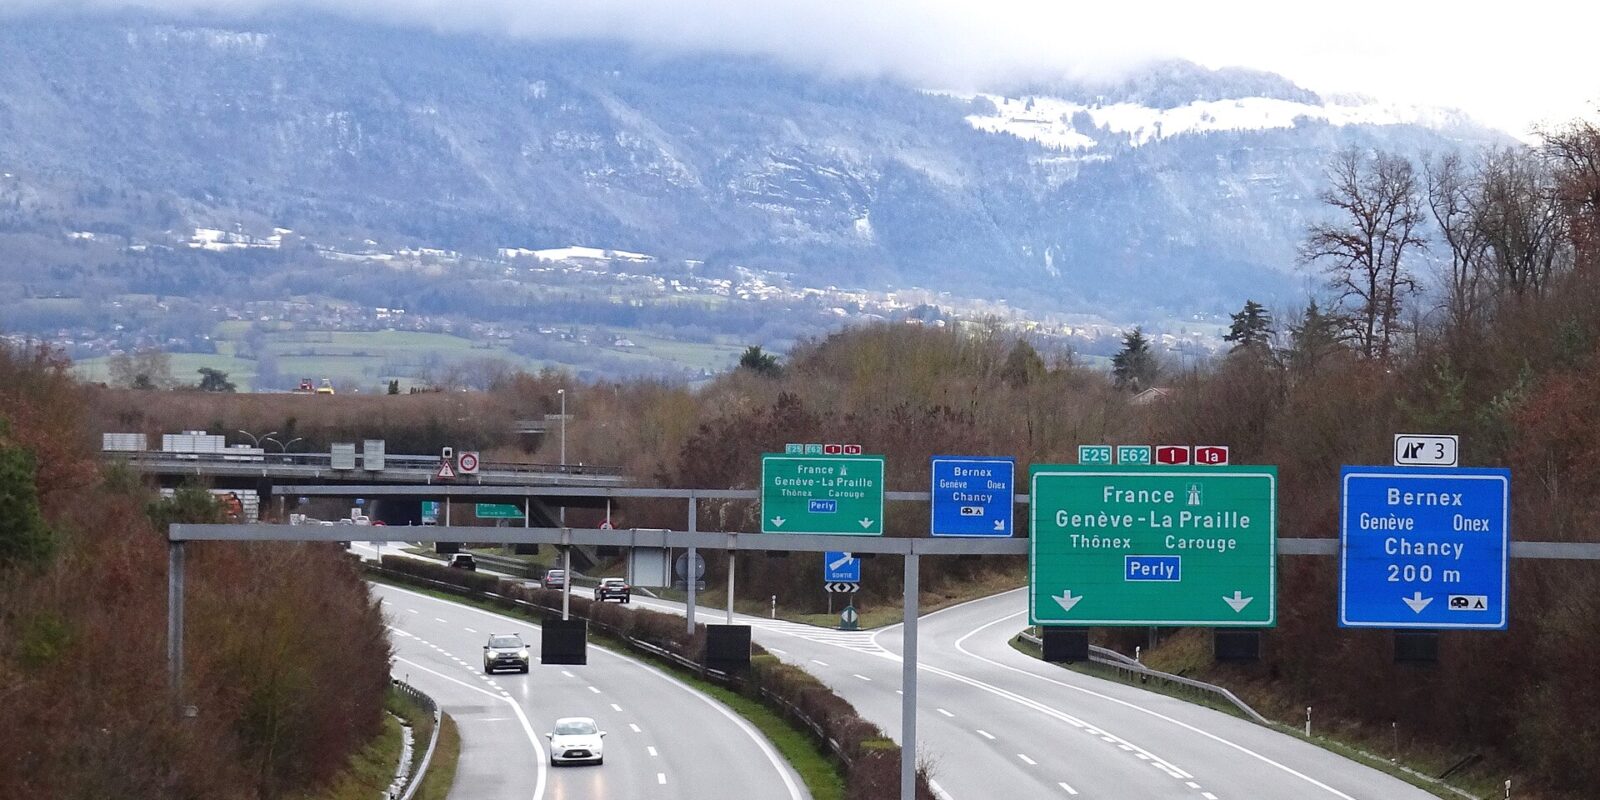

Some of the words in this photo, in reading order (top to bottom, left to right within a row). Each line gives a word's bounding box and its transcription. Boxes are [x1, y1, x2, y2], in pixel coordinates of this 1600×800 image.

[1081, 449, 1109, 462] E25
[1120, 449, 1148, 462] E62
[1169, 449, 1175, 462] 1
[1205, 449, 1219, 462] 1a
[1434, 443, 1445, 459] 3
[797, 464, 834, 474] France
[954, 466, 992, 477] Bernex
[836, 477, 873, 487] Praille
[939, 479, 968, 489] Genève
[987, 480, 1006, 490] Onex
[782, 488, 812, 497] Thônex
[828, 489, 865, 499] Carouge
[952, 492, 993, 504] Chancy
[1103, 485, 1175, 503] France
[1387, 487, 1463, 506] Bernex
[811, 501, 834, 511] Perly
[1179, 511, 1250, 529] Praille
[1360, 512, 1414, 530] Genève
[1453, 514, 1490, 532] Onex
[1070, 534, 1131, 549] Thônex
[1165, 535, 1237, 552] Carouge
[1385, 537, 1464, 559] Chancy
[1130, 561, 1174, 579] Perly
[1387, 564, 1433, 582] 200
[1443, 569, 1461, 583] m
